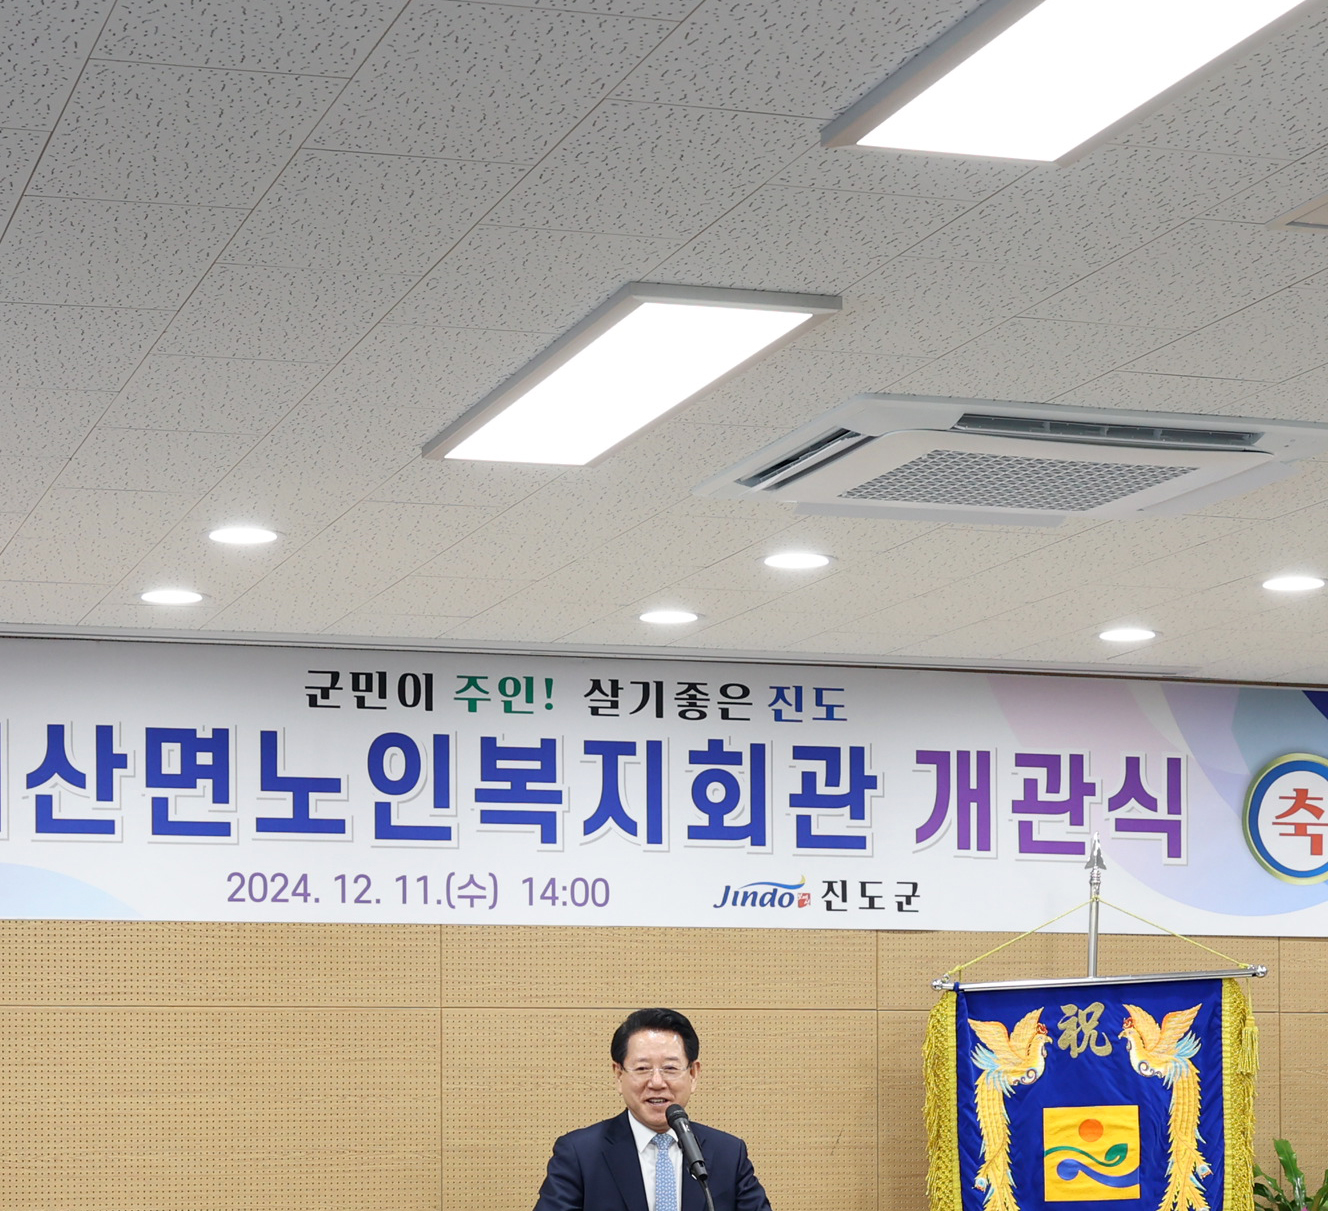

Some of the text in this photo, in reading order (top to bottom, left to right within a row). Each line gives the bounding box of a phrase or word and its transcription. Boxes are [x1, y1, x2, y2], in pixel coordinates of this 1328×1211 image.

[304, 669, 848, 723] 군민이 주인! 살기좋은 진도
[915, 748, 1187, 859] 개관식
[226, 871, 611, 910] 2024. 12. 11.(수) 14:00
[713, 885, 796, 908] Jindo
[821, 879, 921, 912] 진도군
[1057, 1002, 1113, 1059] 祝
